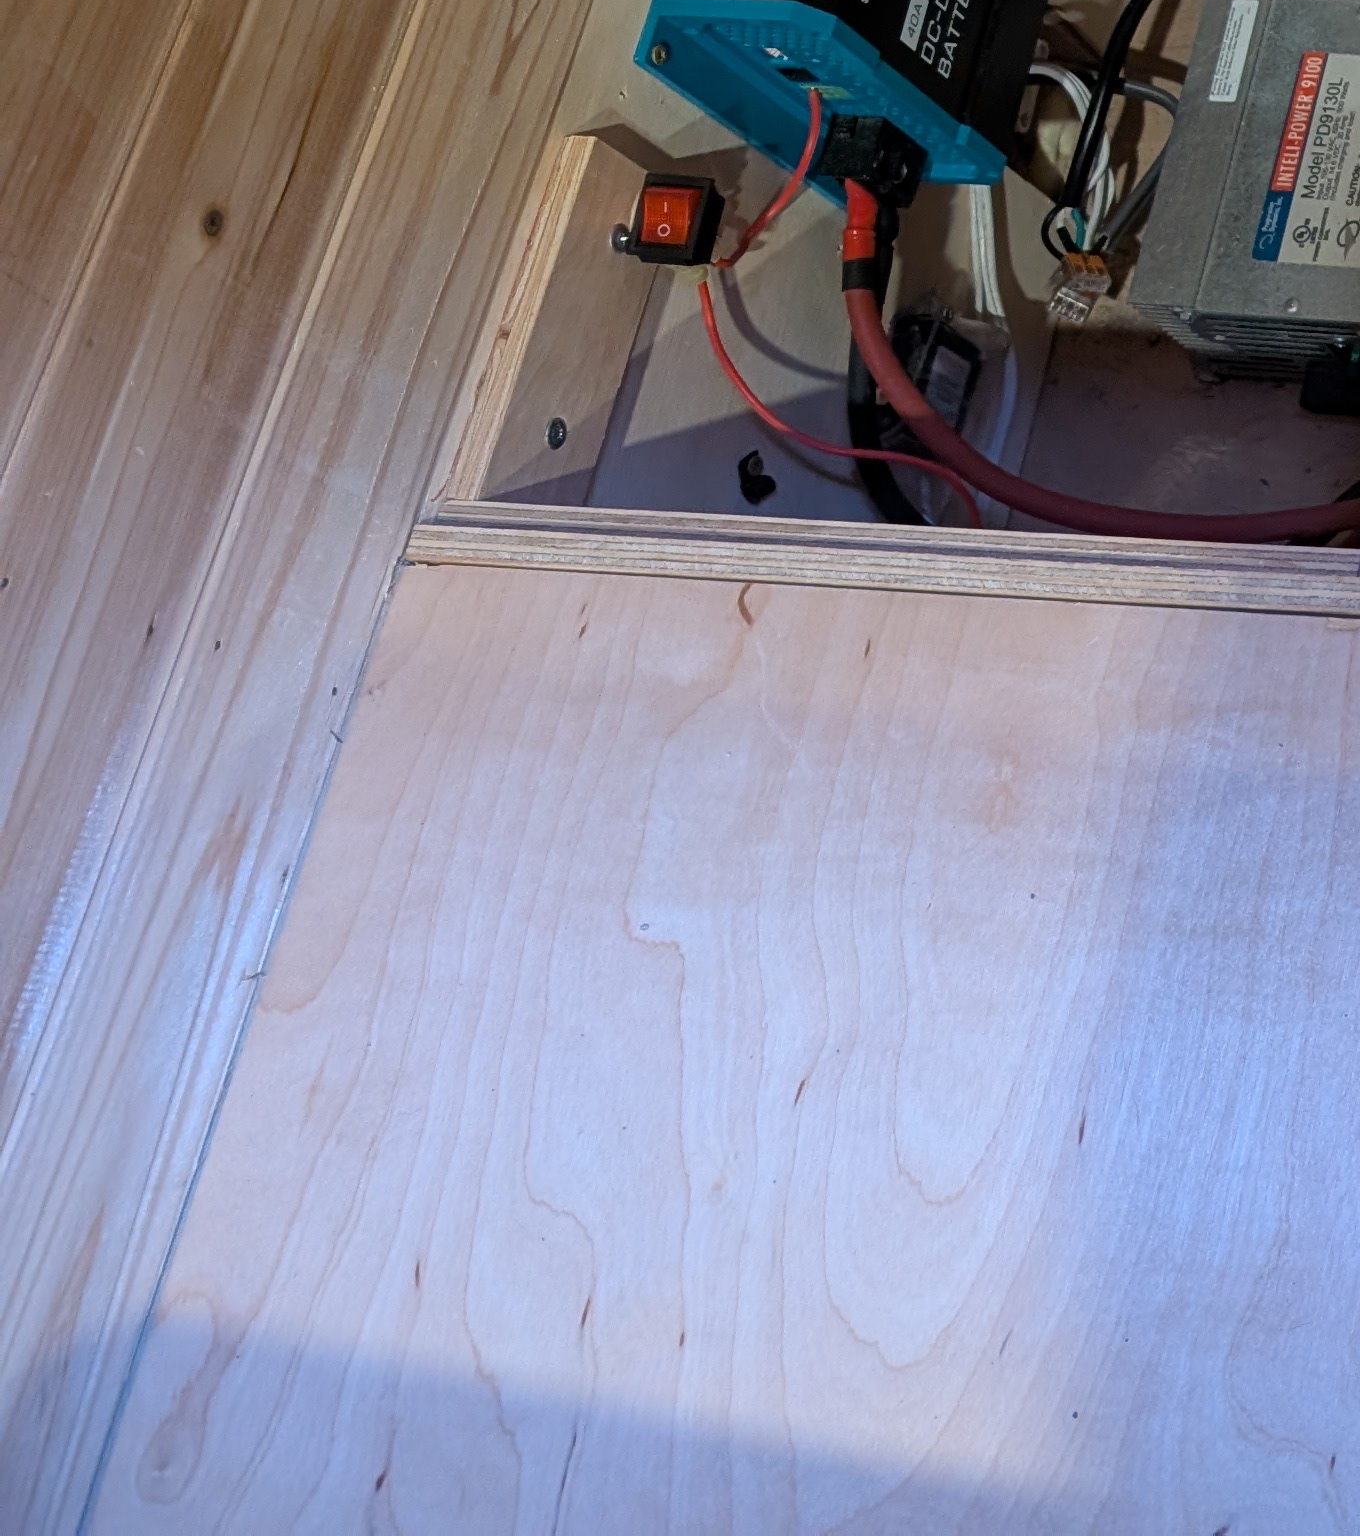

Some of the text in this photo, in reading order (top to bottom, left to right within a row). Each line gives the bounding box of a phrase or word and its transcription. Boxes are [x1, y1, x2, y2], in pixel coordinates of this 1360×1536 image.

[907, 3, 923, 39] 40A
[1277, 56, 1323, 186] INTELI-POWER 9100
[1301, 76, 1343, 198] Model PD9130L
